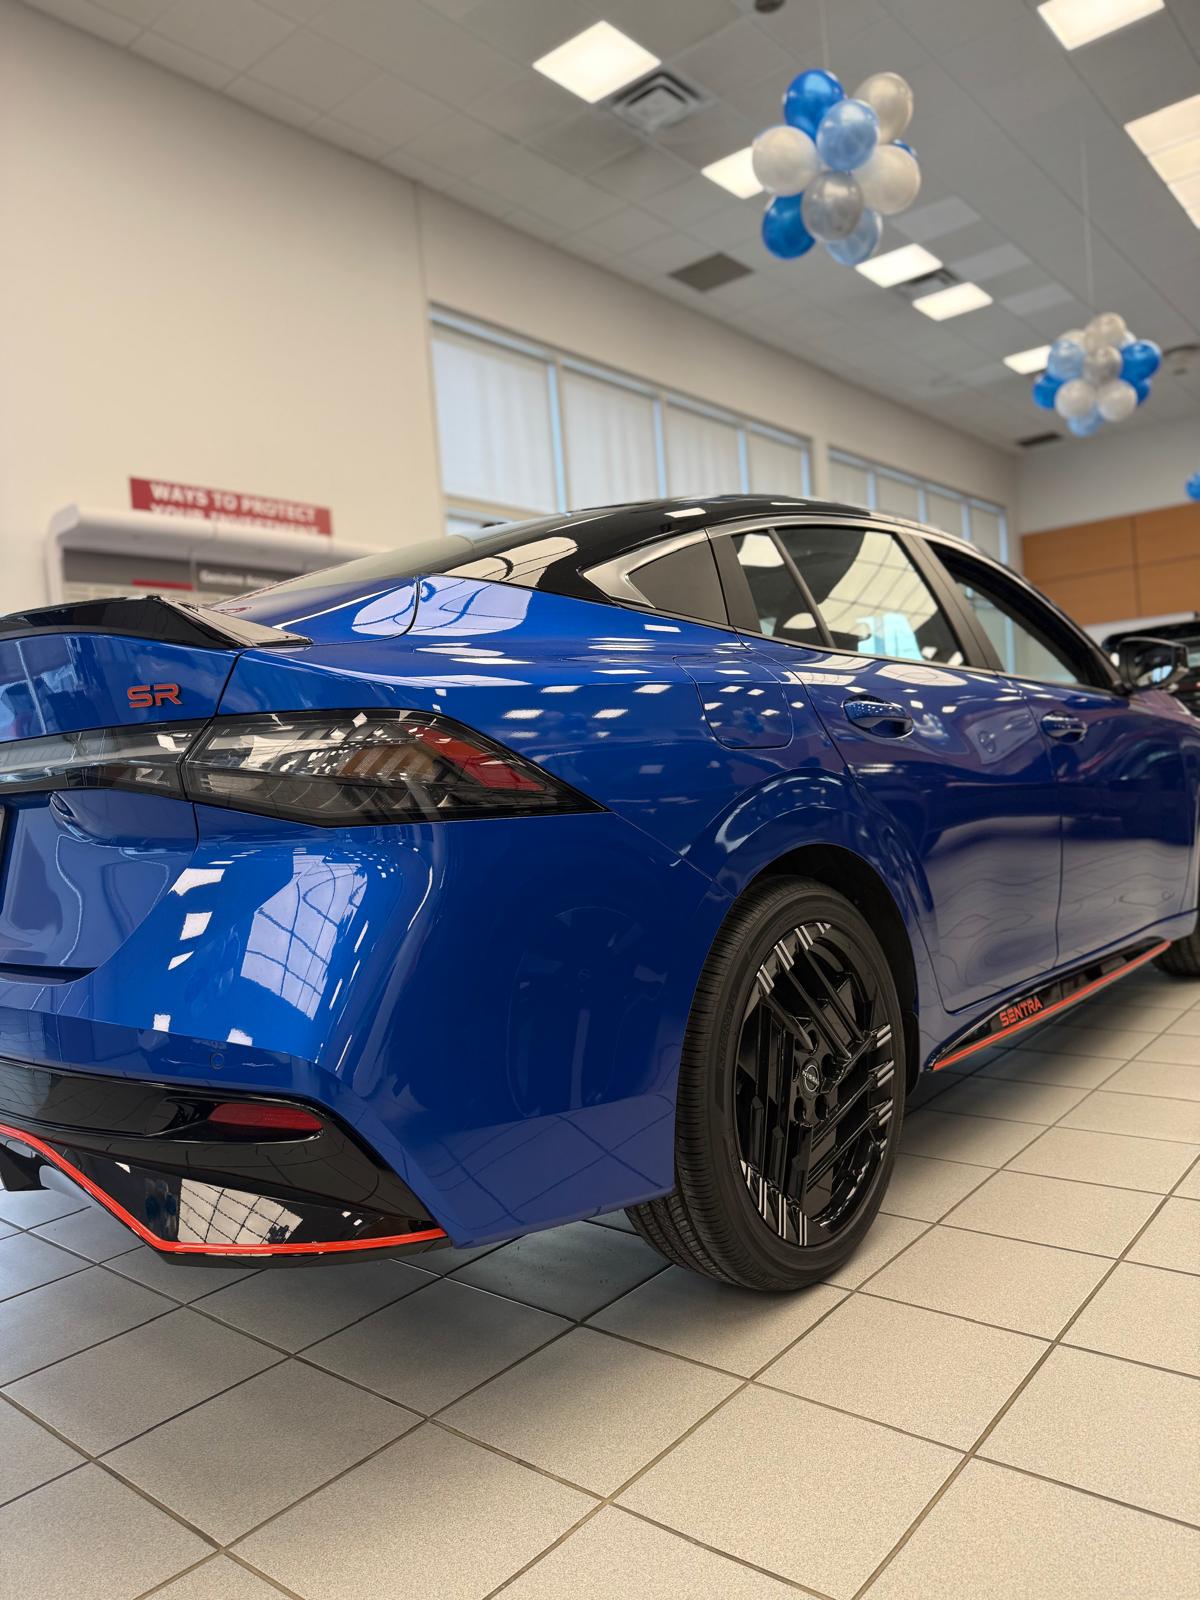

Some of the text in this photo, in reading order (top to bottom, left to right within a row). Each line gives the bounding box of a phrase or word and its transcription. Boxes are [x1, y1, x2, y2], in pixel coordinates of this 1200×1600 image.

[150, 481, 208, 507] WAYS
[210, 492, 238, 512] TO
[241, 495, 315, 524] PROTECT
[127, 683, 182, 708] SR
[999, 995, 1043, 1027] SENTRA
